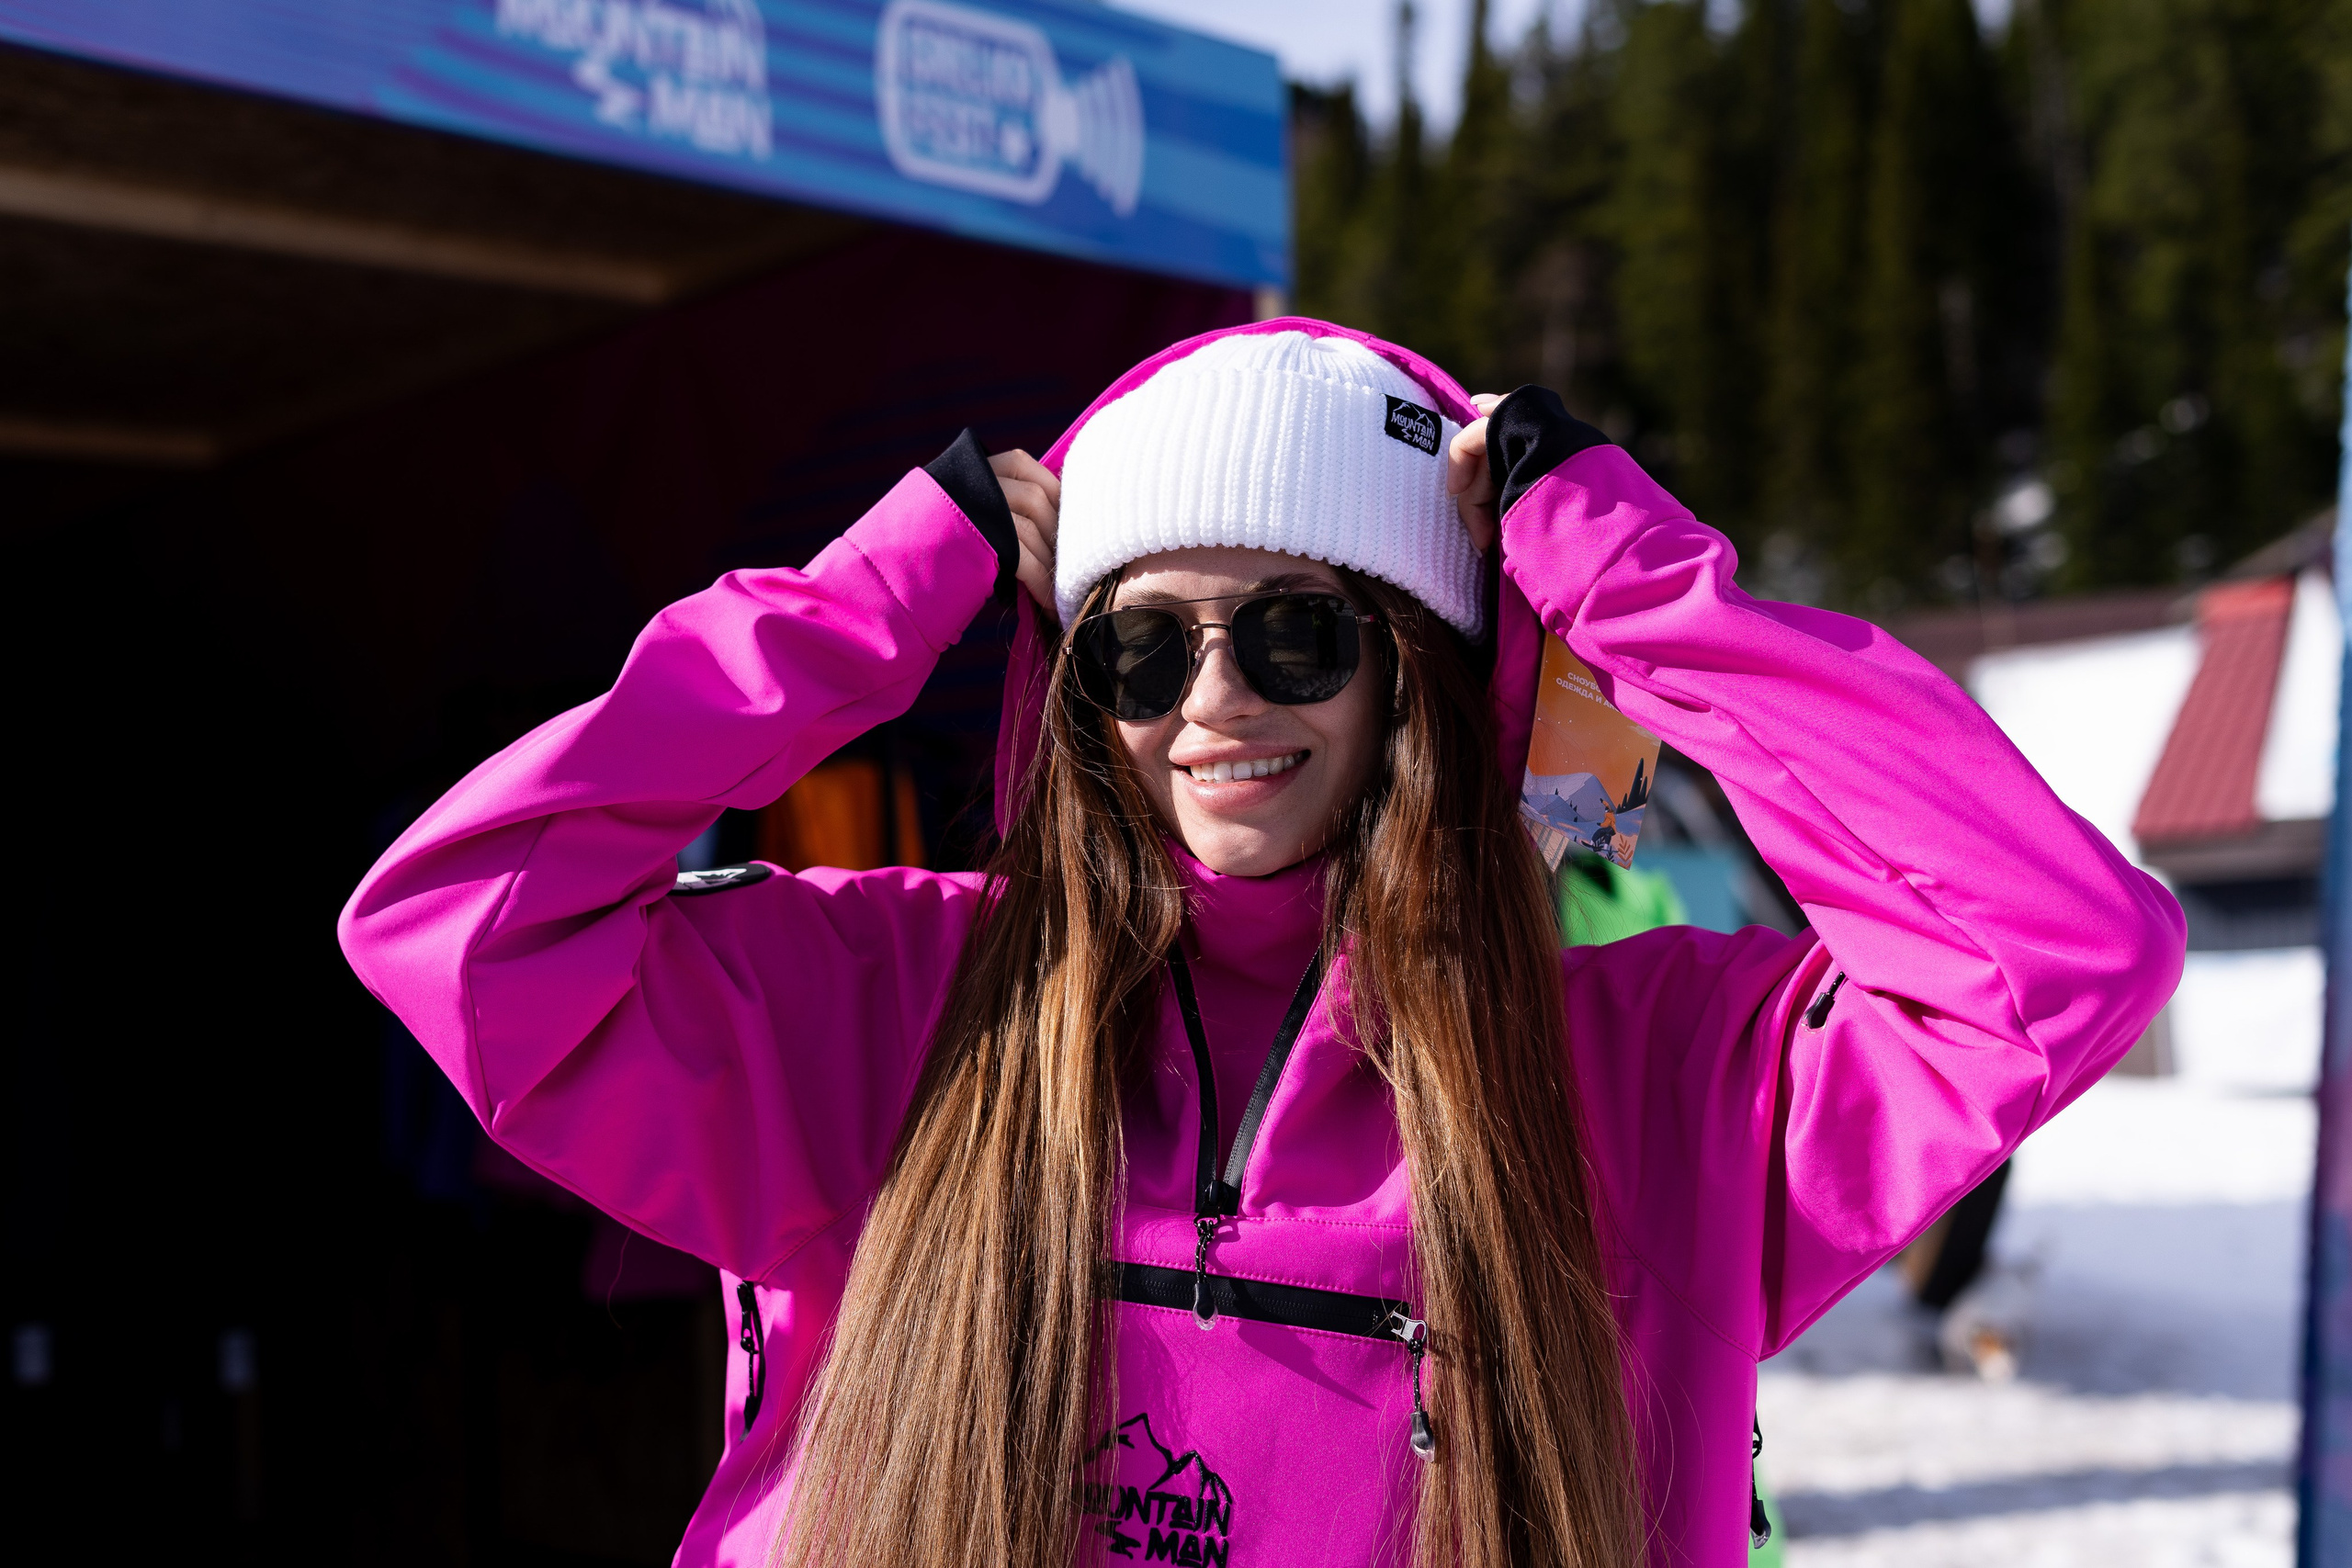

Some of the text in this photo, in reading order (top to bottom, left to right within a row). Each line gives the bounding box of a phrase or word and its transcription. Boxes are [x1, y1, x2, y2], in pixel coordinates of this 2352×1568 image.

[1391, 412, 1435, 441] MOUNTAIN
[1412, 434, 1434, 450] MAN
[1555, 677, 1602, 705] ОДЕЖДА И
[1080, 1482, 1231, 1538] OUNTAIN
[1145, 1527, 1229, 1568] MAN
